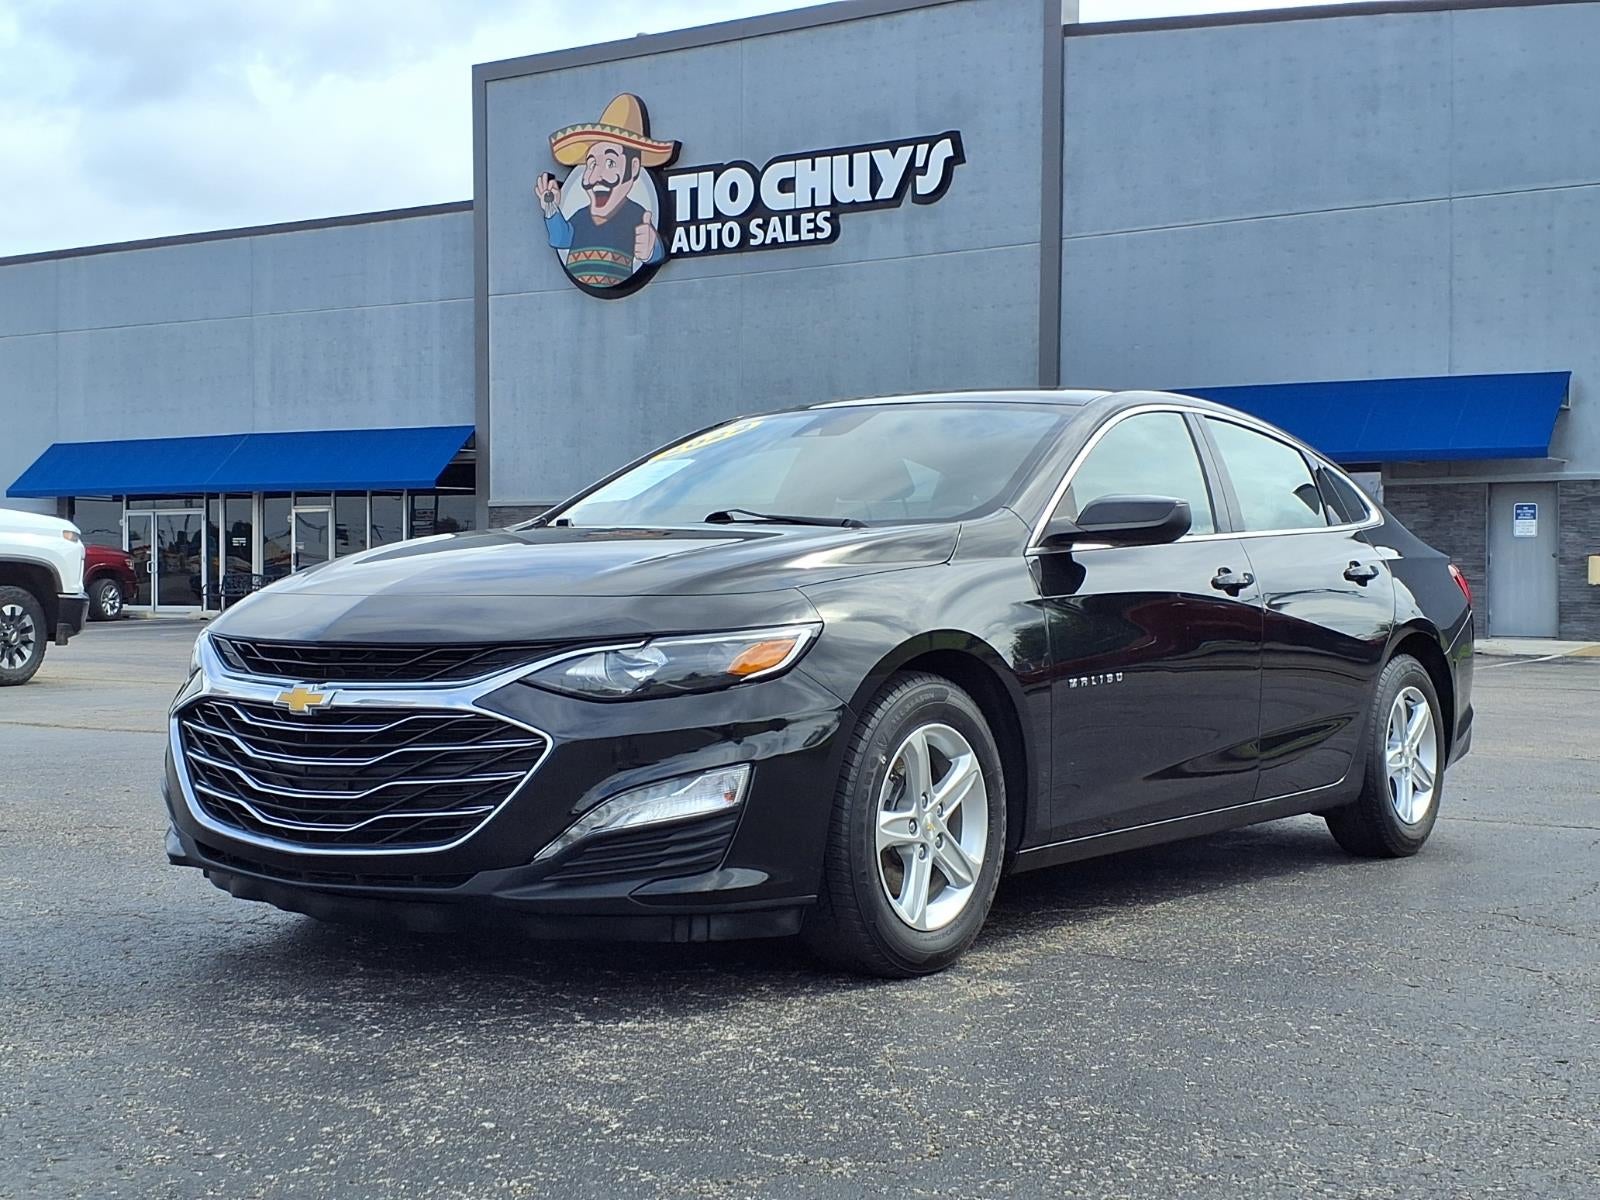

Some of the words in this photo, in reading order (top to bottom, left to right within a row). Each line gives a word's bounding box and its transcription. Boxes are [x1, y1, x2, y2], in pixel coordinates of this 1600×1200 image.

[667, 167, 755, 222] TIO
[760, 138, 954, 211] CHUY'S
[670, 221, 741, 253] AUTO
[749, 211, 832, 246] SALES
[1068, 672, 1123, 688] MALIBU
